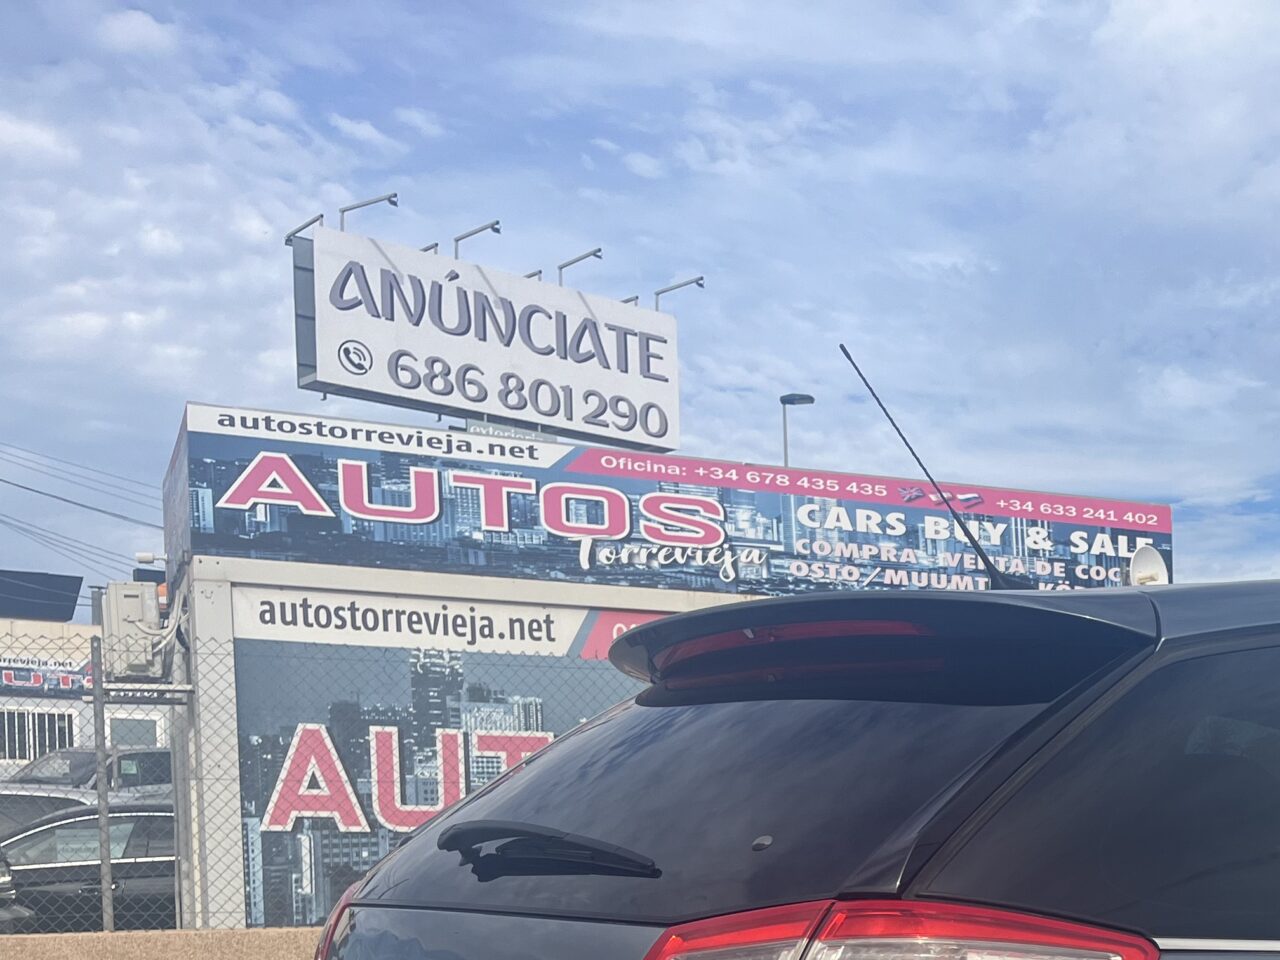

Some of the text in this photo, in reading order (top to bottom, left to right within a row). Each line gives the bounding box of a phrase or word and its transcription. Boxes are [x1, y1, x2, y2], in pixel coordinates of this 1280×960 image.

[329, 261, 669, 382] ANÚNCIATE
[387, 349, 668, 438] 686 801 290
[217, 412, 540, 460] autostorrevieja.net
[600, 455, 888, 496] Oficina: +34 678 435 435
[215, 451, 726, 549] AUTOS
[996, 500, 1158, 526] +34 633 241 402
[796, 503, 907, 536] CARS
[924, 515, 1008, 546] BUY
[1026, 527, 1055, 551] &
[568, 537, 769, 582] Torrevieja
[795, 538, 918, 564] COMPRA
[1035, 560, 1066, 577] DE
[259, 597, 556, 645] autostorrevieja.net
